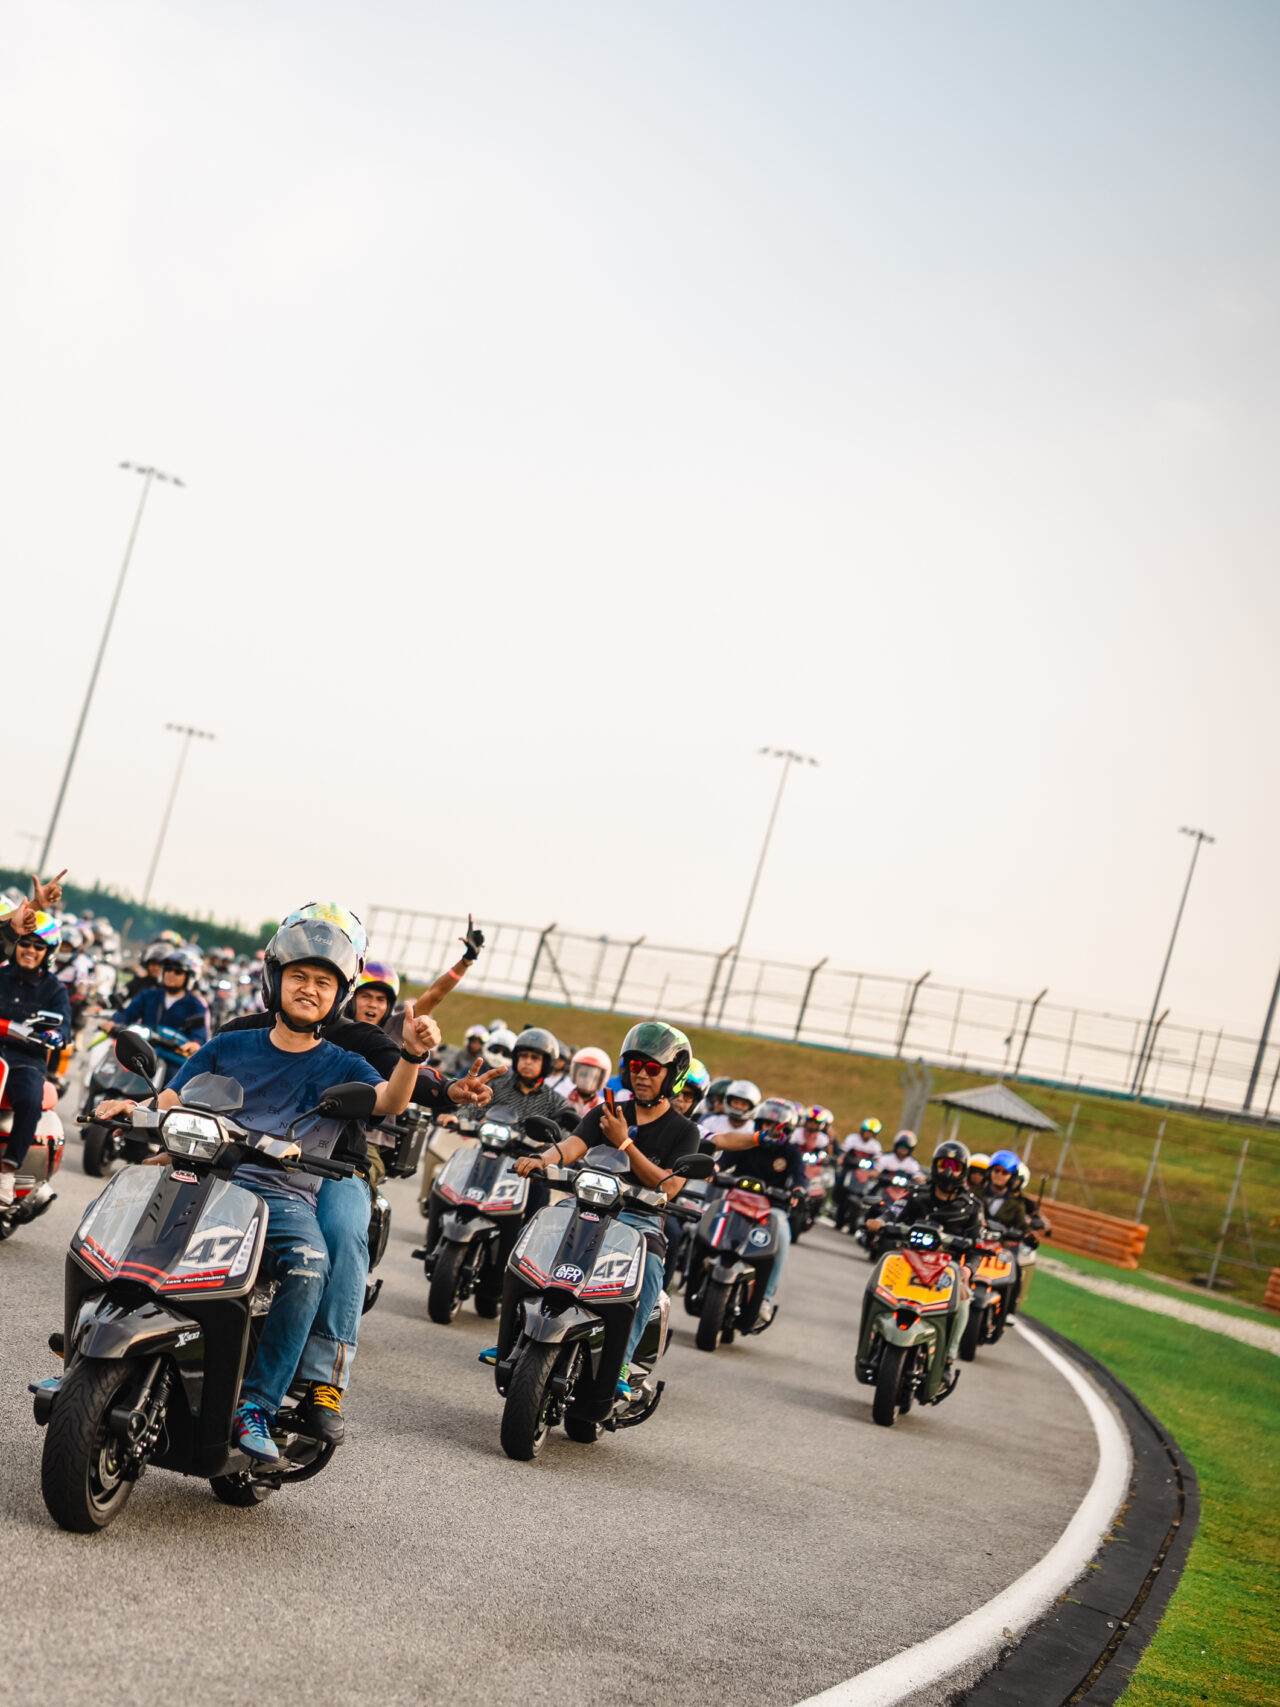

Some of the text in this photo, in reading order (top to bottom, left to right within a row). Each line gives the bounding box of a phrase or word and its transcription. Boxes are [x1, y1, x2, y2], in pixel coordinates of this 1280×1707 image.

[182, 1236, 244, 1264] 47
[557, 1265, 582, 1277] APD
[593, 1259, 632, 1279] 47
[174, 1331, 200, 1348] X300
